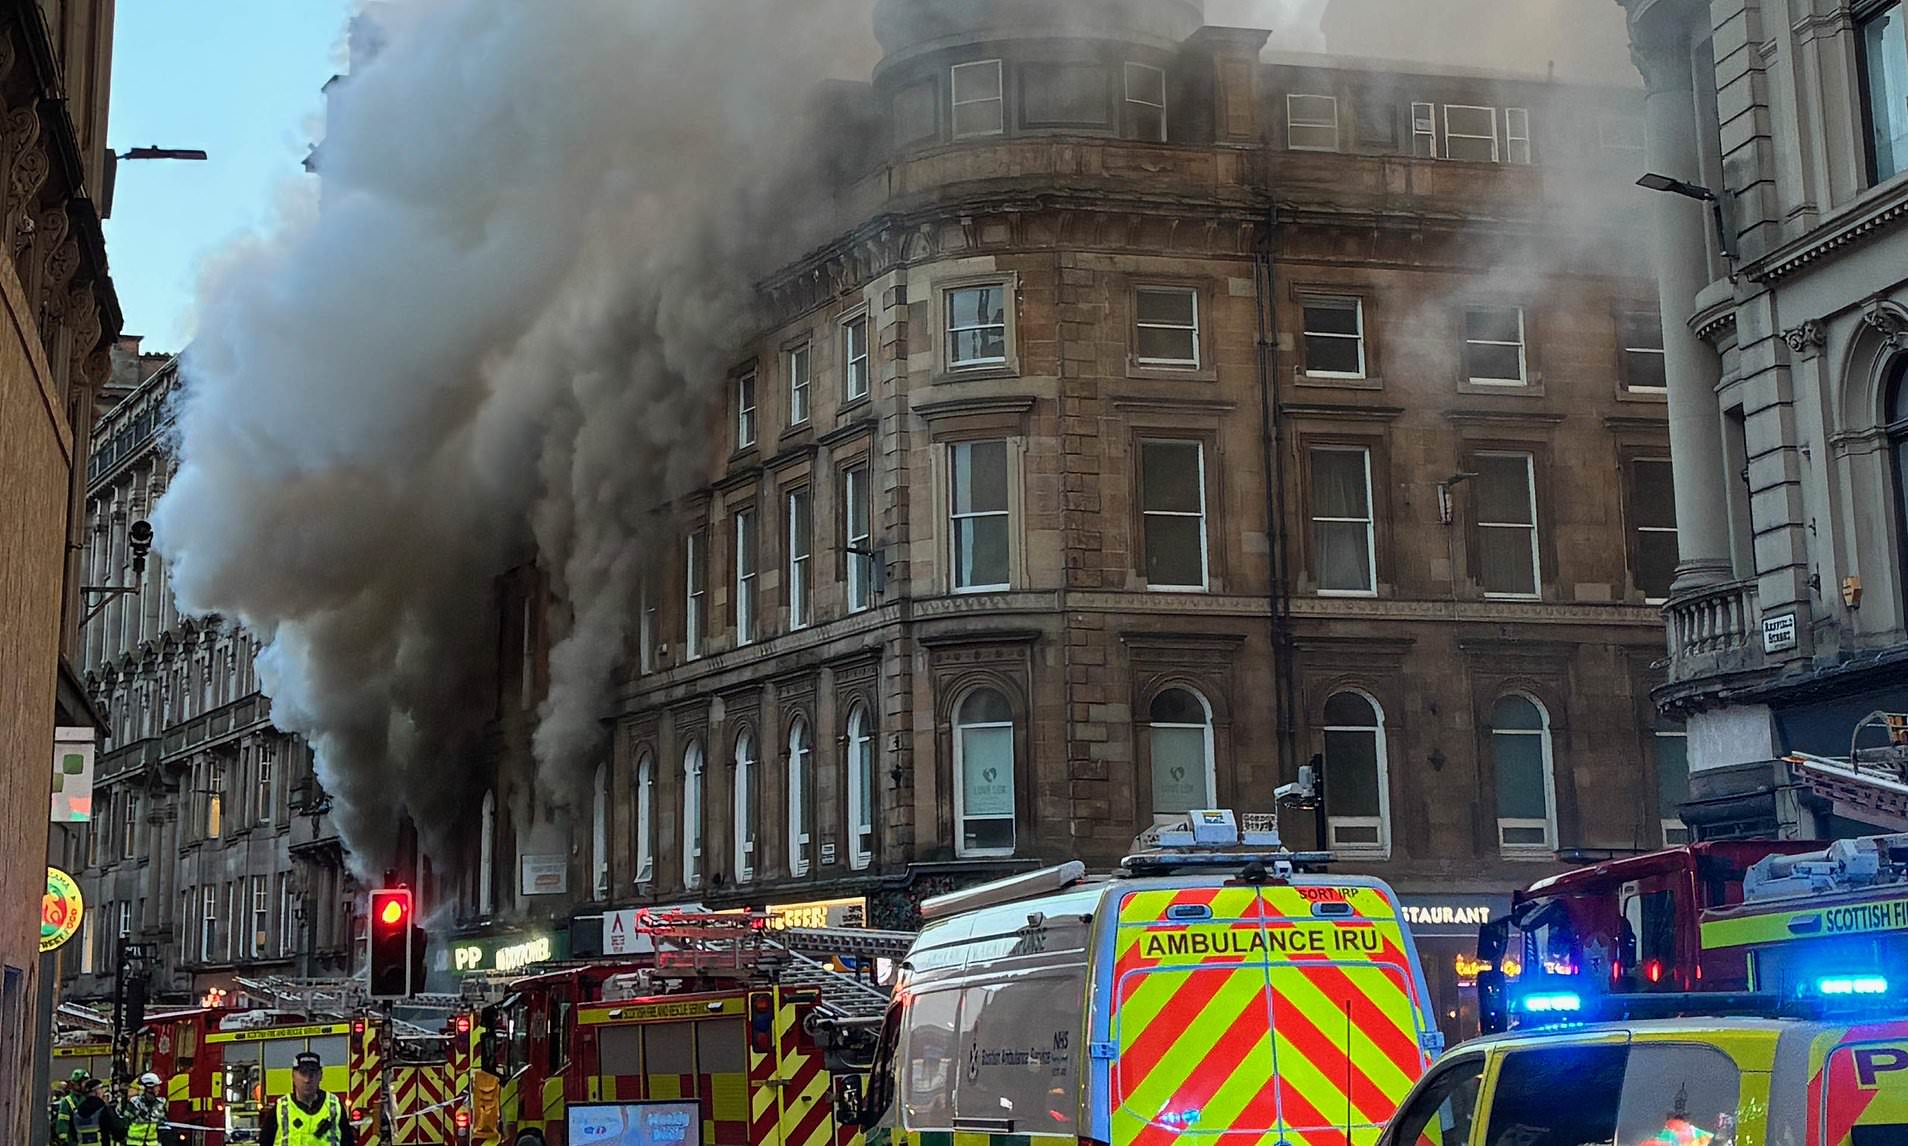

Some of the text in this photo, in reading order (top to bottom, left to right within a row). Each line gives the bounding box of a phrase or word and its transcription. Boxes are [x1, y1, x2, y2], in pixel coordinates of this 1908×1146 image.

[1299, 887, 1359, 900] SORT IRP
[1401, 907, 1490, 924] STAURANT
[1826, 904, 1891, 932] SCOTTISH
[1146, 929, 1378, 956] AMBULANCE IRU
[1053, 1031, 1069, 1050] NHS
